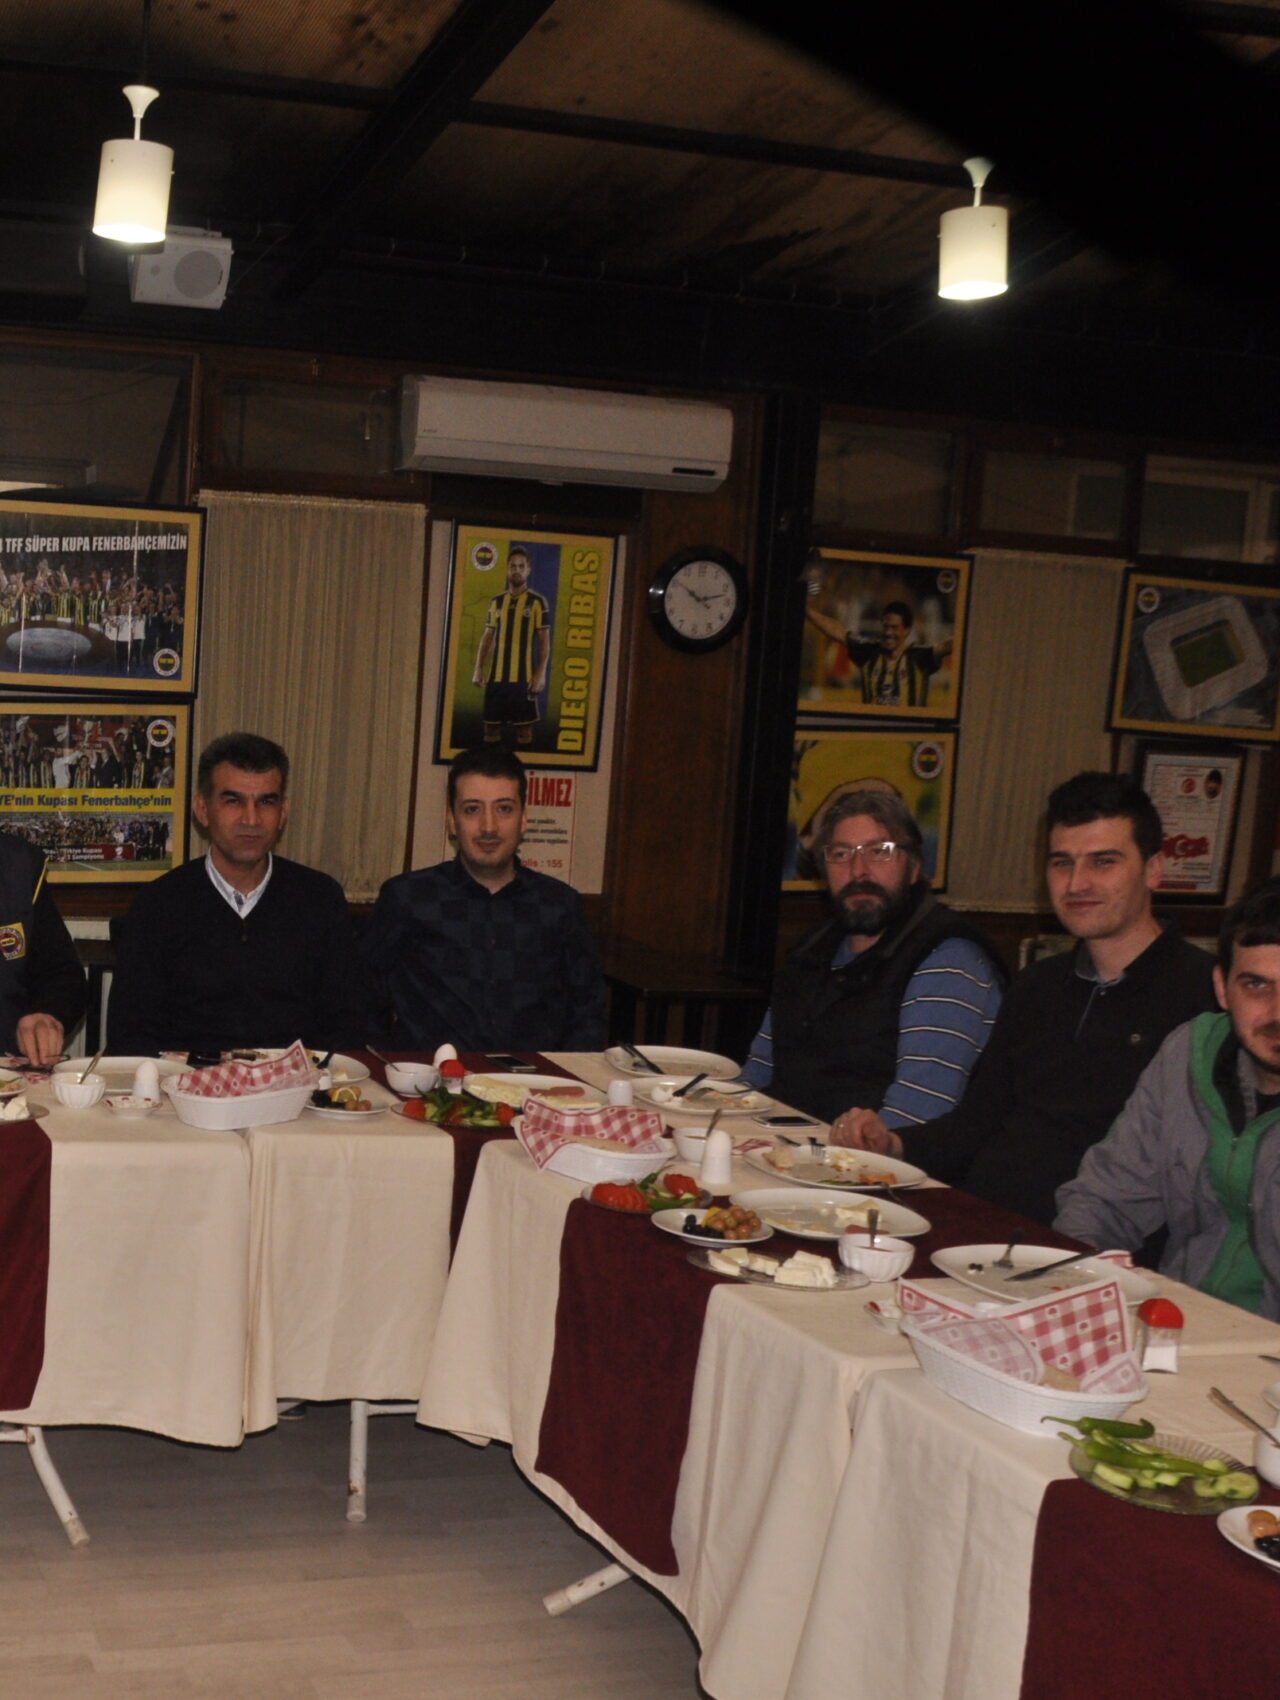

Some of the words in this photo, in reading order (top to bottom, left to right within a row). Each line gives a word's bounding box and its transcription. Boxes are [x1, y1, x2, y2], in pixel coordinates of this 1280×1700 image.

[5, 537, 24, 554] TFF
[25, 534, 60, 553] SÜPER
[61, 536, 91, 552] KUPA
[92, 533, 188, 554] FENERBAHÇEMİZİN
[566, 550, 601, 650] RIBAS
[557, 656, 591, 751] DIEGO
[37, 794, 78, 808] Kupası
[81, 794, 172, 808] Fenerbahçe'nin
[527, 770, 573, 807] İLMEZ
[522, 858, 539, 868] olis
